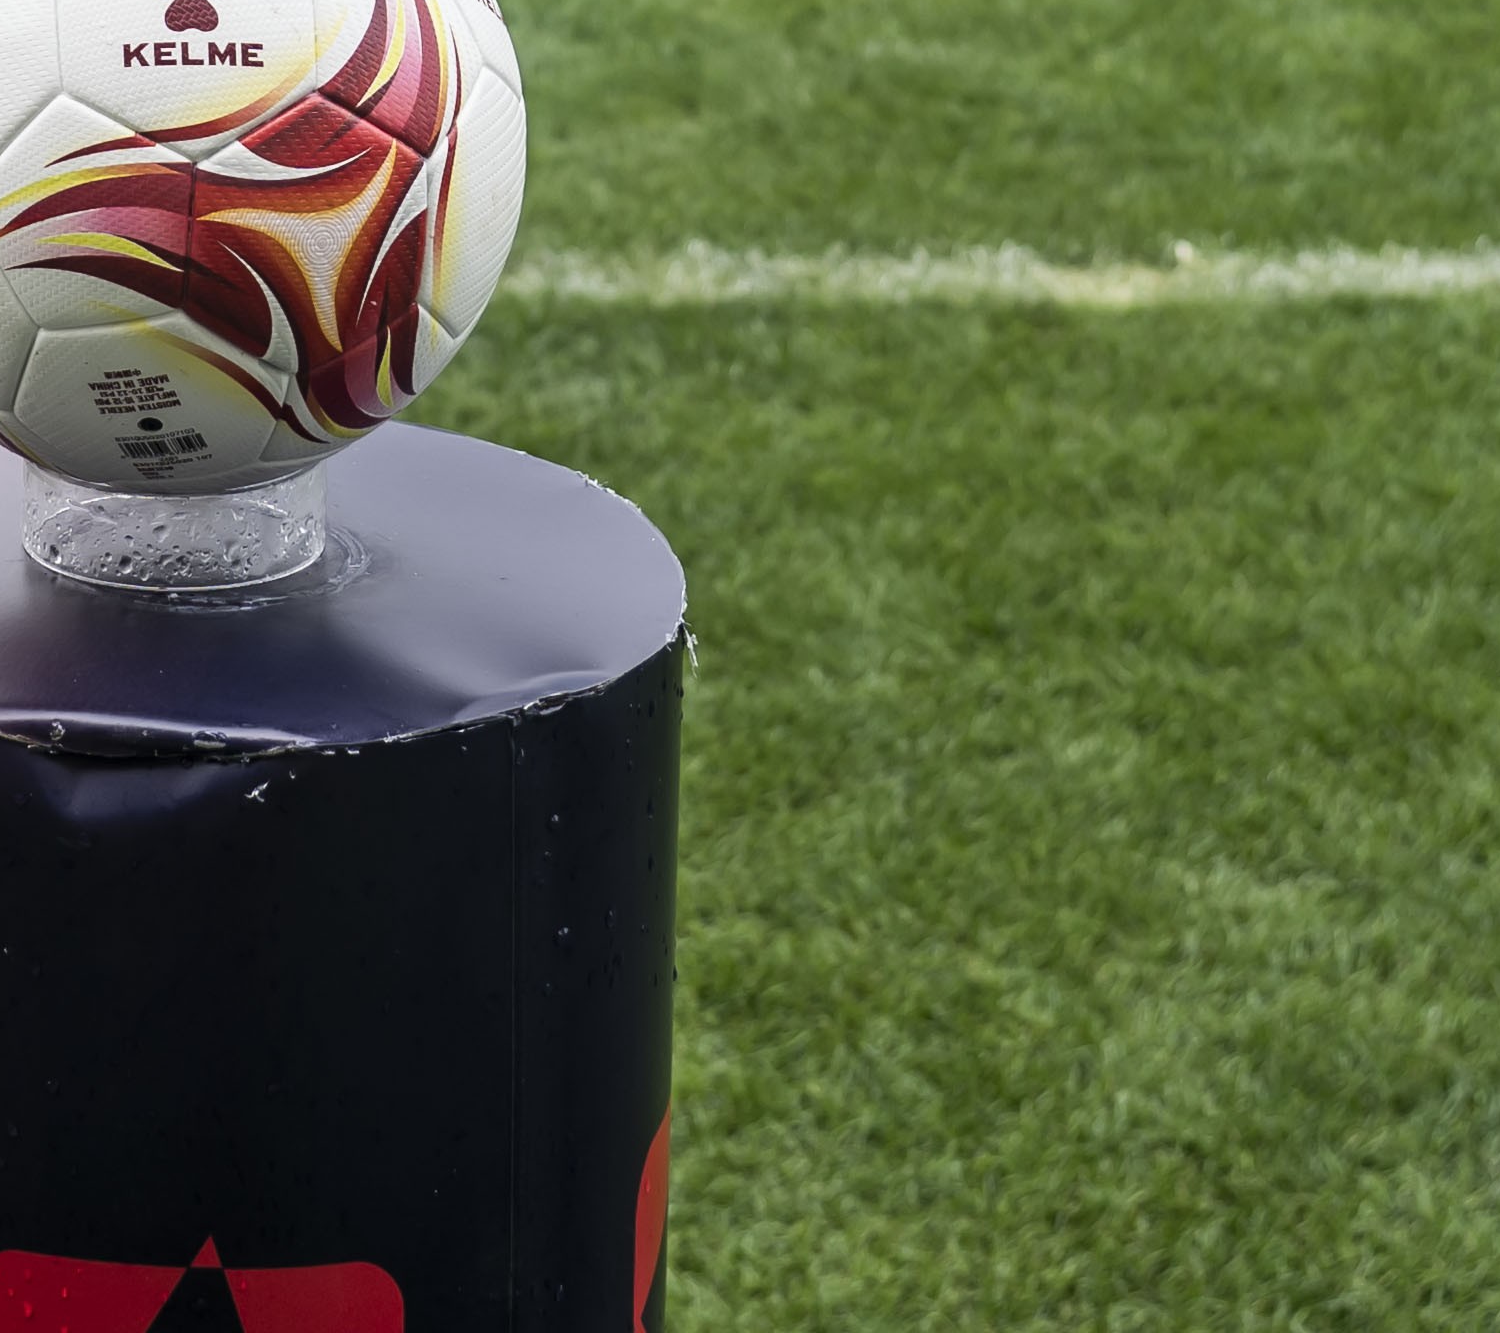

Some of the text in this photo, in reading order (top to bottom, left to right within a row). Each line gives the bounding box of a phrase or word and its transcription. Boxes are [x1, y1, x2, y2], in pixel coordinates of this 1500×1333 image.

[123, 42, 264, 68] KELME
[88, 374, 170, 391] MADE IN CHINA
[94, 398, 113, 406] PSI
[137, 390, 178, 403] INFLATE
[98, 399, 181, 414] MOISTEN NEEDLE
